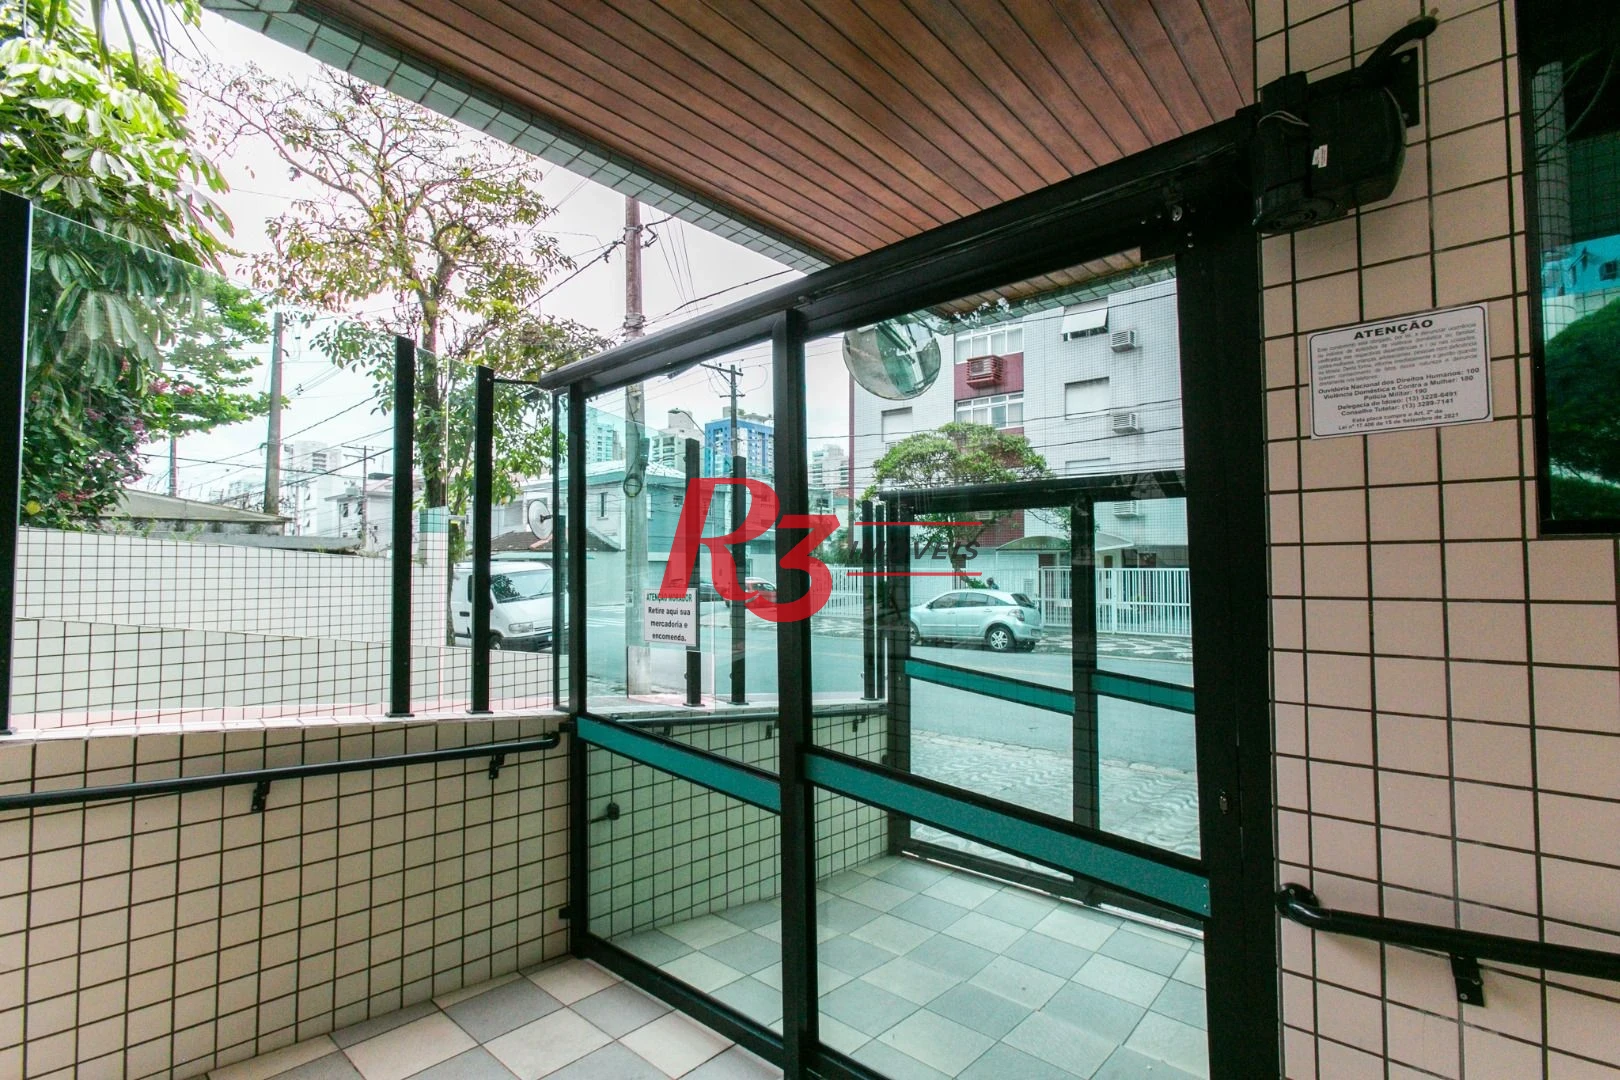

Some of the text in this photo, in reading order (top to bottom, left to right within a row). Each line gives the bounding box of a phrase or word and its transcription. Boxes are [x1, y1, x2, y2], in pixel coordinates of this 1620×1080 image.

[1353, 319, 1433, 340] ATENÇÃO
[1351, 381, 1379, 390] Nacional
[1396, 375, 1423, 383] Direitos
[666, 608, 678, 616] aqui
[651, 620, 682, 628] mercadoria
[652, 633, 686, 641] encomenda.
